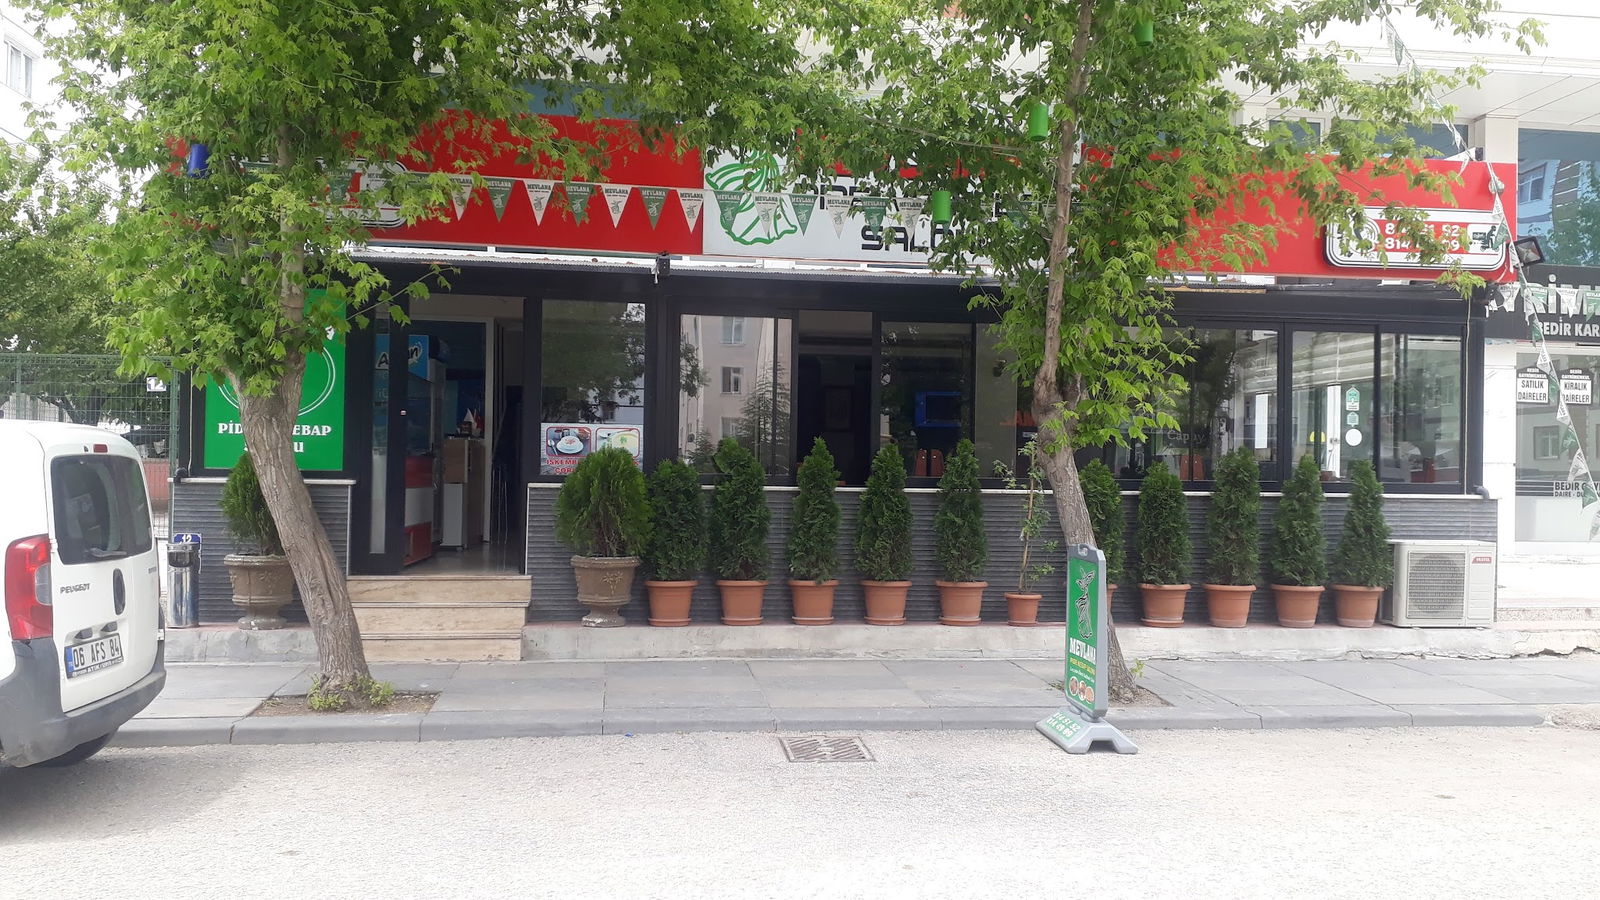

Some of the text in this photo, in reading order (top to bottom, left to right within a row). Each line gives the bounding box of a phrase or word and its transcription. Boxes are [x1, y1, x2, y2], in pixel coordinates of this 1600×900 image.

[1521, 380, 1544, 389] SATILIK
[291, 424, 332, 436] EBAP
[60, 583, 90, 594] PEUGEOT
[73, 647, 85, 669] 06
[91, 641, 106, 663] AFS
[109, 638, 120, 657] 84
[1069, 637, 1096, 666] MEVLANA
